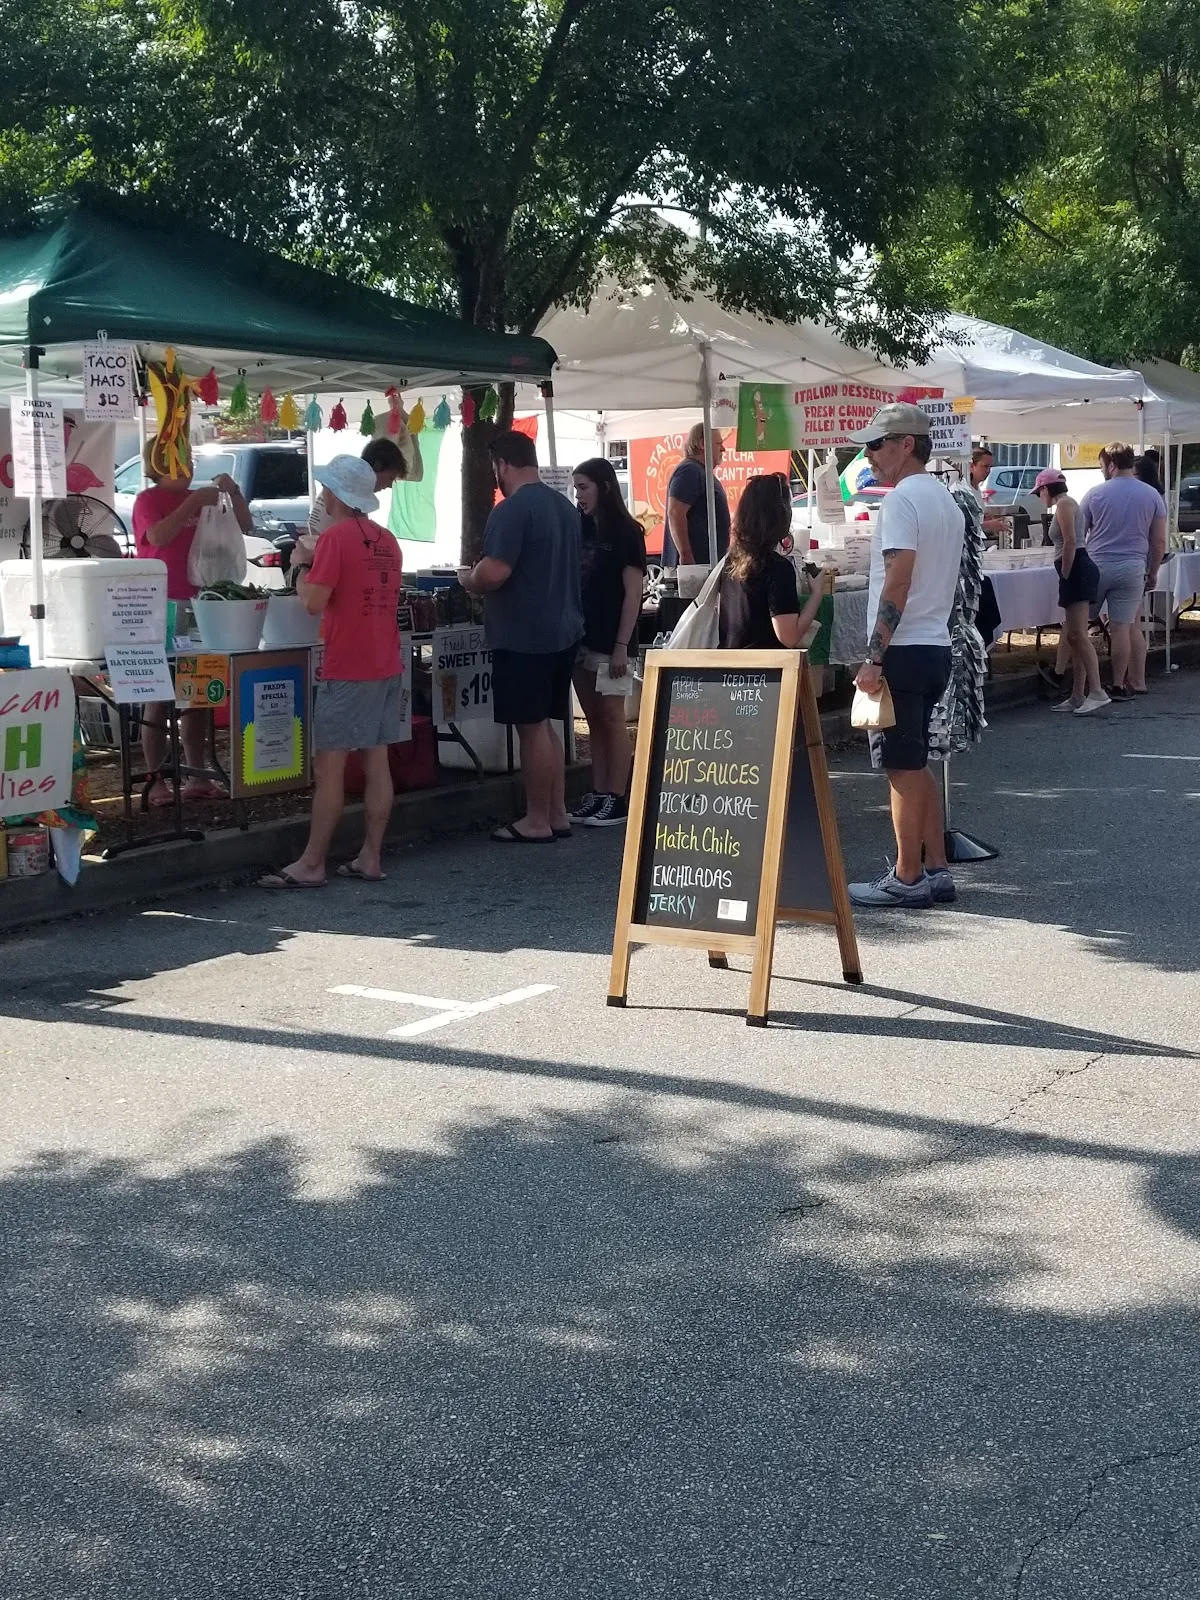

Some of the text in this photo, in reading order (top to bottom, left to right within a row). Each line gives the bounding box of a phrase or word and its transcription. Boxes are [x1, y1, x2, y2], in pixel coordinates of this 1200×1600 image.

[88, 355, 127, 368] TACO
[90, 374, 126, 388] HATS
[98, 393, 119, 407] $12
[794, 384, 894, 405] ITALIAN DESSERTS
[23, 400, 53, 409] FRED'S
[21, 410, 56, 419] SPECIAL
[804, 419, 835, 433] FILLED
[645, 434, 684, 478] STATIO
[721, 447, 755, 462] ETCHA
[715, 466, 765, 481] CAN'T EAT
[438, 651, 478, 669] SWEET
[125, 668, 154, 676] CHILIES
[210, 684, 221, 698] $1
[263, 683, 286, 691] FRED'S
[671, 673, 767, 692] APPLE ICED TEA
[0, 689, 60, 717] can
[676, 689, 763, 701] SNACKS WATER
[670, 705, 759, 727] SALSAS CHIPS
[4, 723, 42, 772] H
[665, 727, 734, 751] PICKLES
[663, 758, 760, 786] HOT SAUCES
[0, 772, 57, 801] lies
[659, 791, 760, 820] PICKLED OKRA
[655, 822, 741, 857] Hatch Chilis
[653, 864, 733, 890] ENCHILADAS
[649, 893, 697, 921] JERKY
